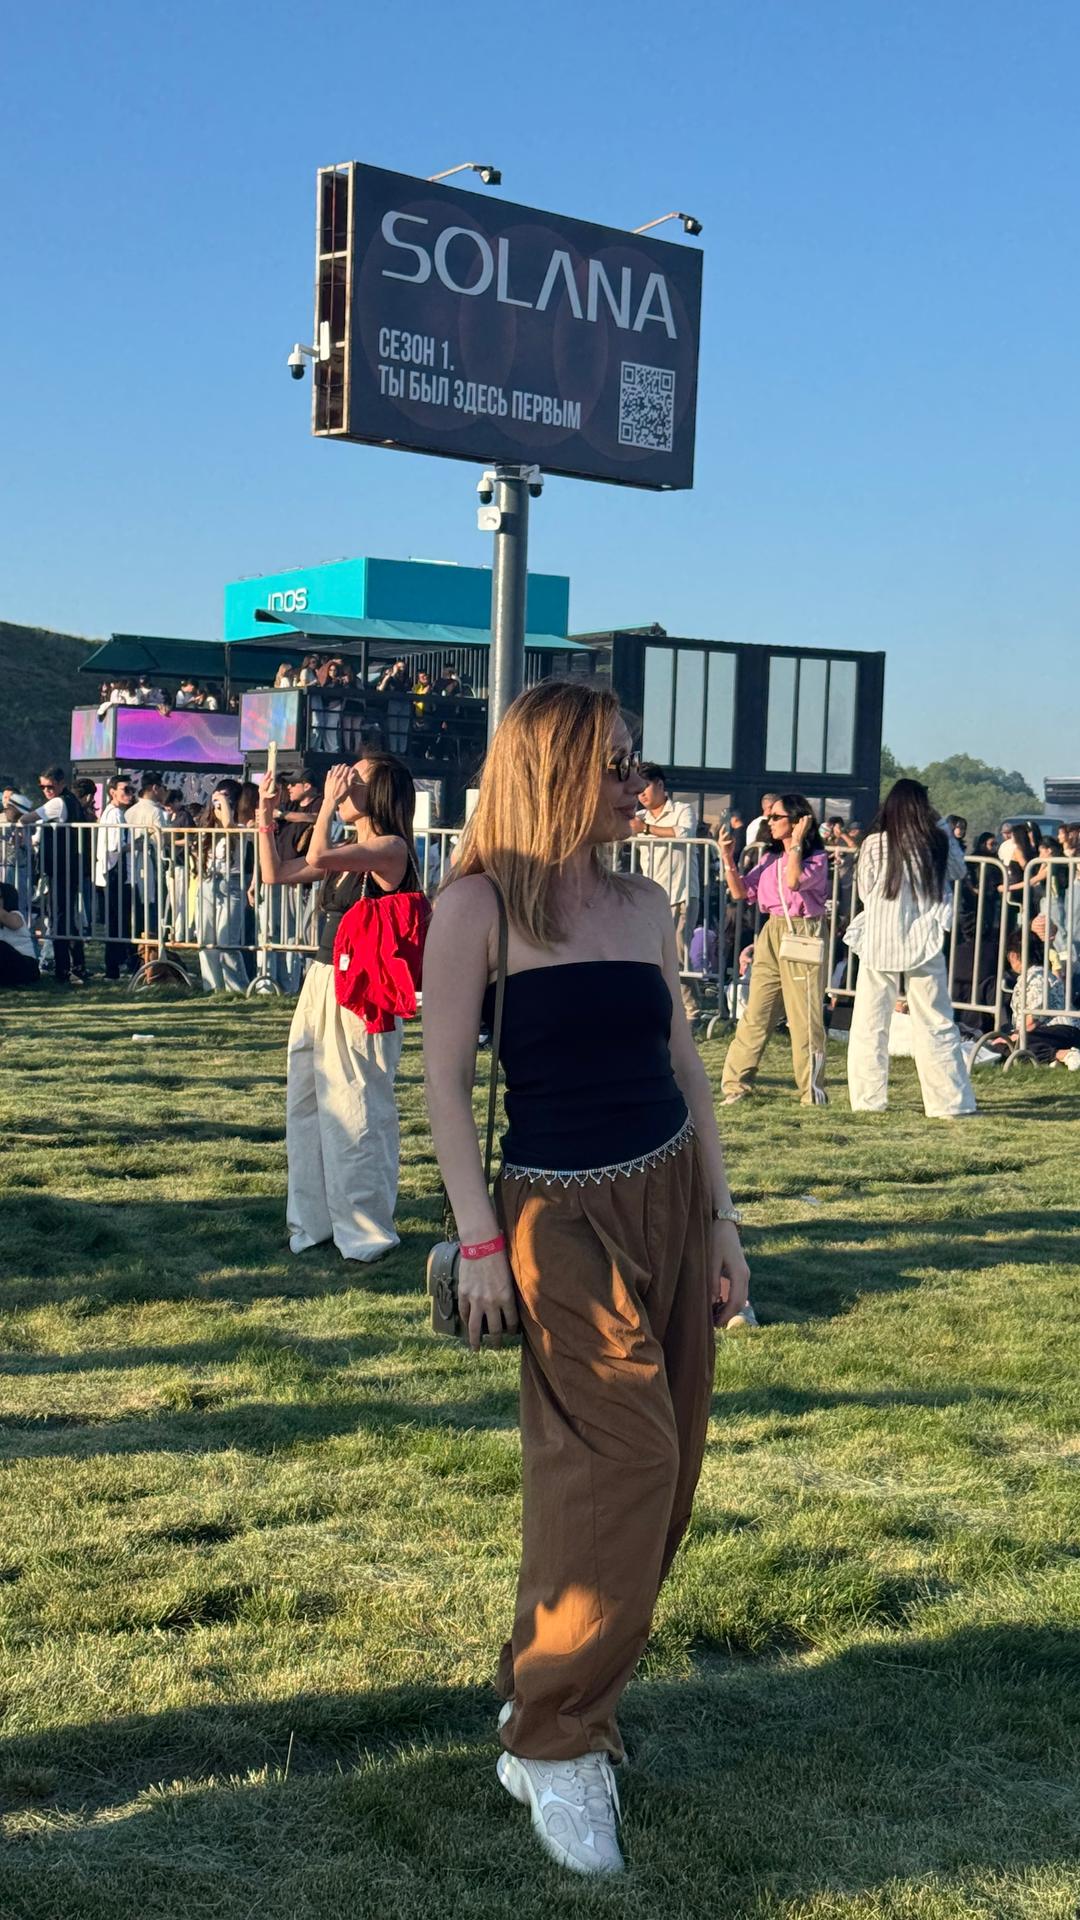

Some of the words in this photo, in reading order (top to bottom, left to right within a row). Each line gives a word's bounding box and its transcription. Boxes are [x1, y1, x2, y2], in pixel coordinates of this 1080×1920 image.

[381, 210, 678, 339] SOLANA
[378, 327, 435, 367] СЕЗОН
[441, 340, 455, 371] 1.
[378, 364, 405, 398] ТЫ
[409, 369, 450, 407] БЫЛ
[453, 379, 508, 417] ЗДЕСЬ
[511, 390, 582, 430] ПЕРВЫМ
